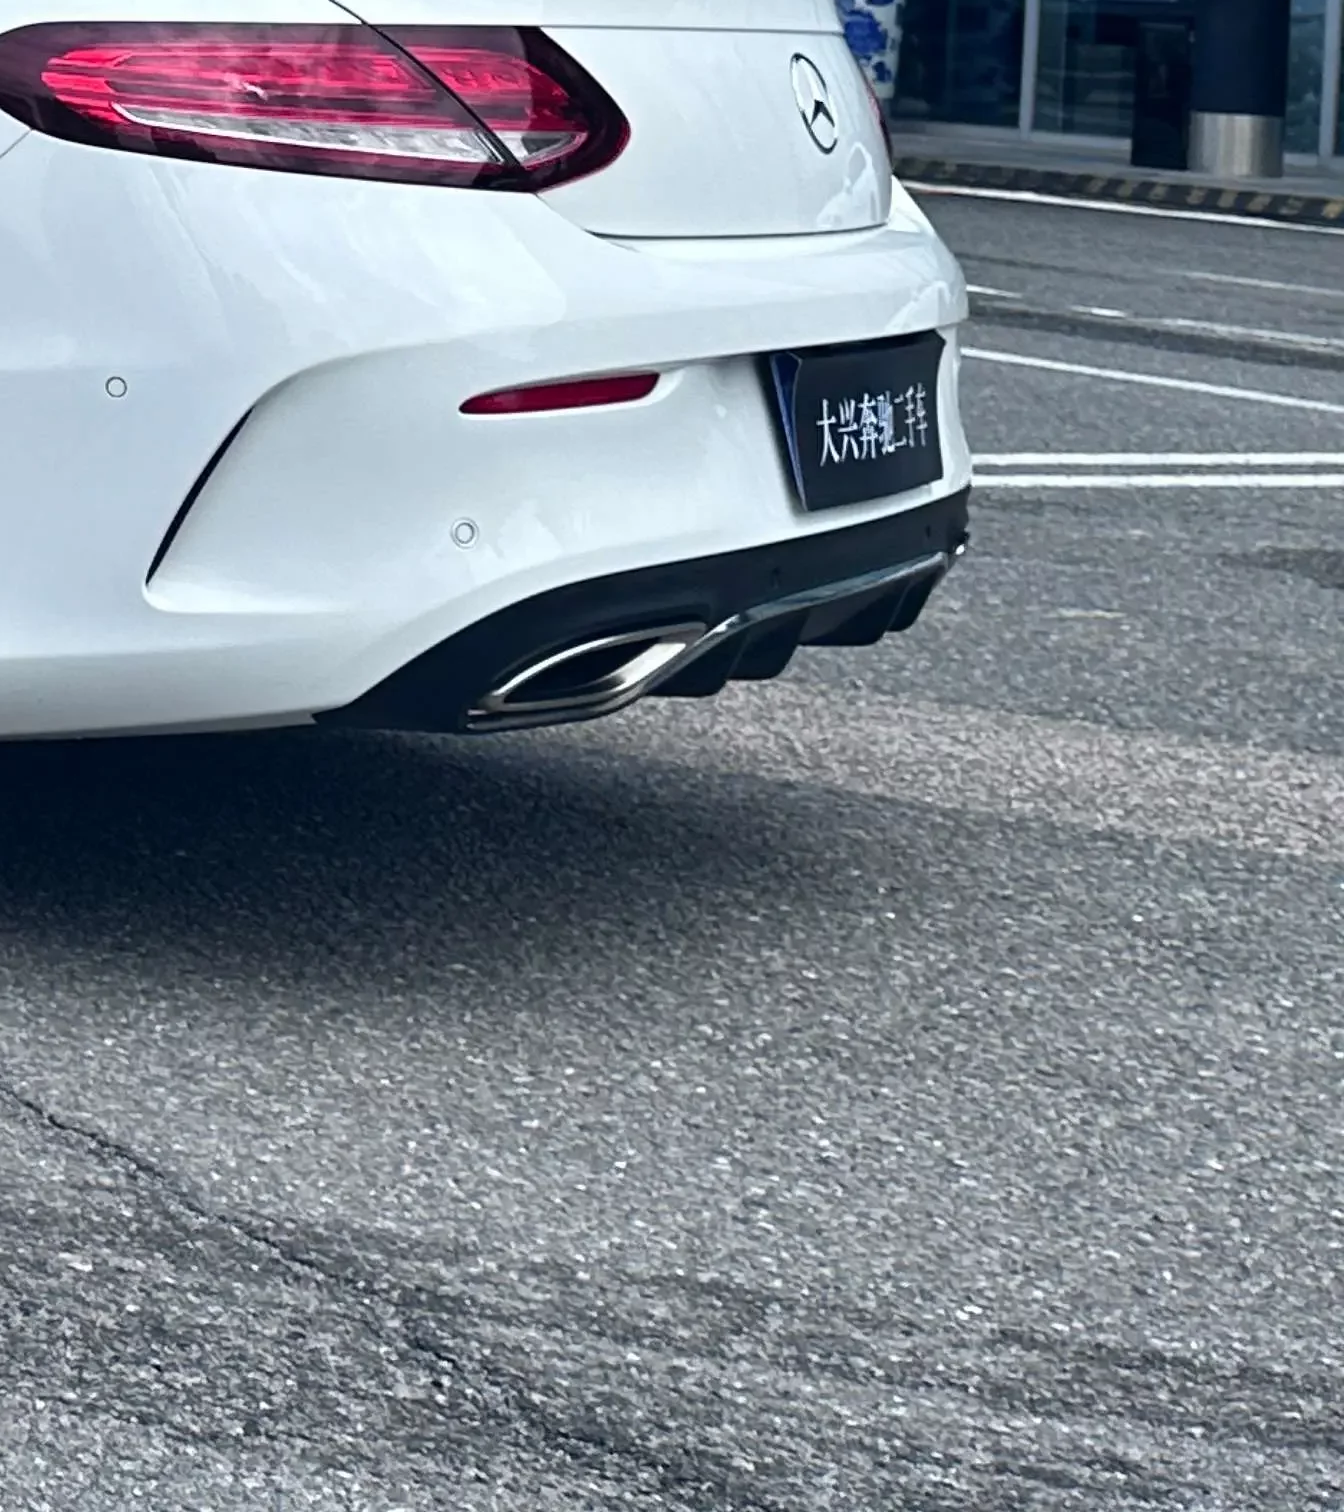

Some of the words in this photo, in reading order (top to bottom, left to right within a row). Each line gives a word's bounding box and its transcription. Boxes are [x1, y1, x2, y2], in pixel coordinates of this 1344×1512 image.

[816, 383, 928, 467] 大兴奔驰二手车
